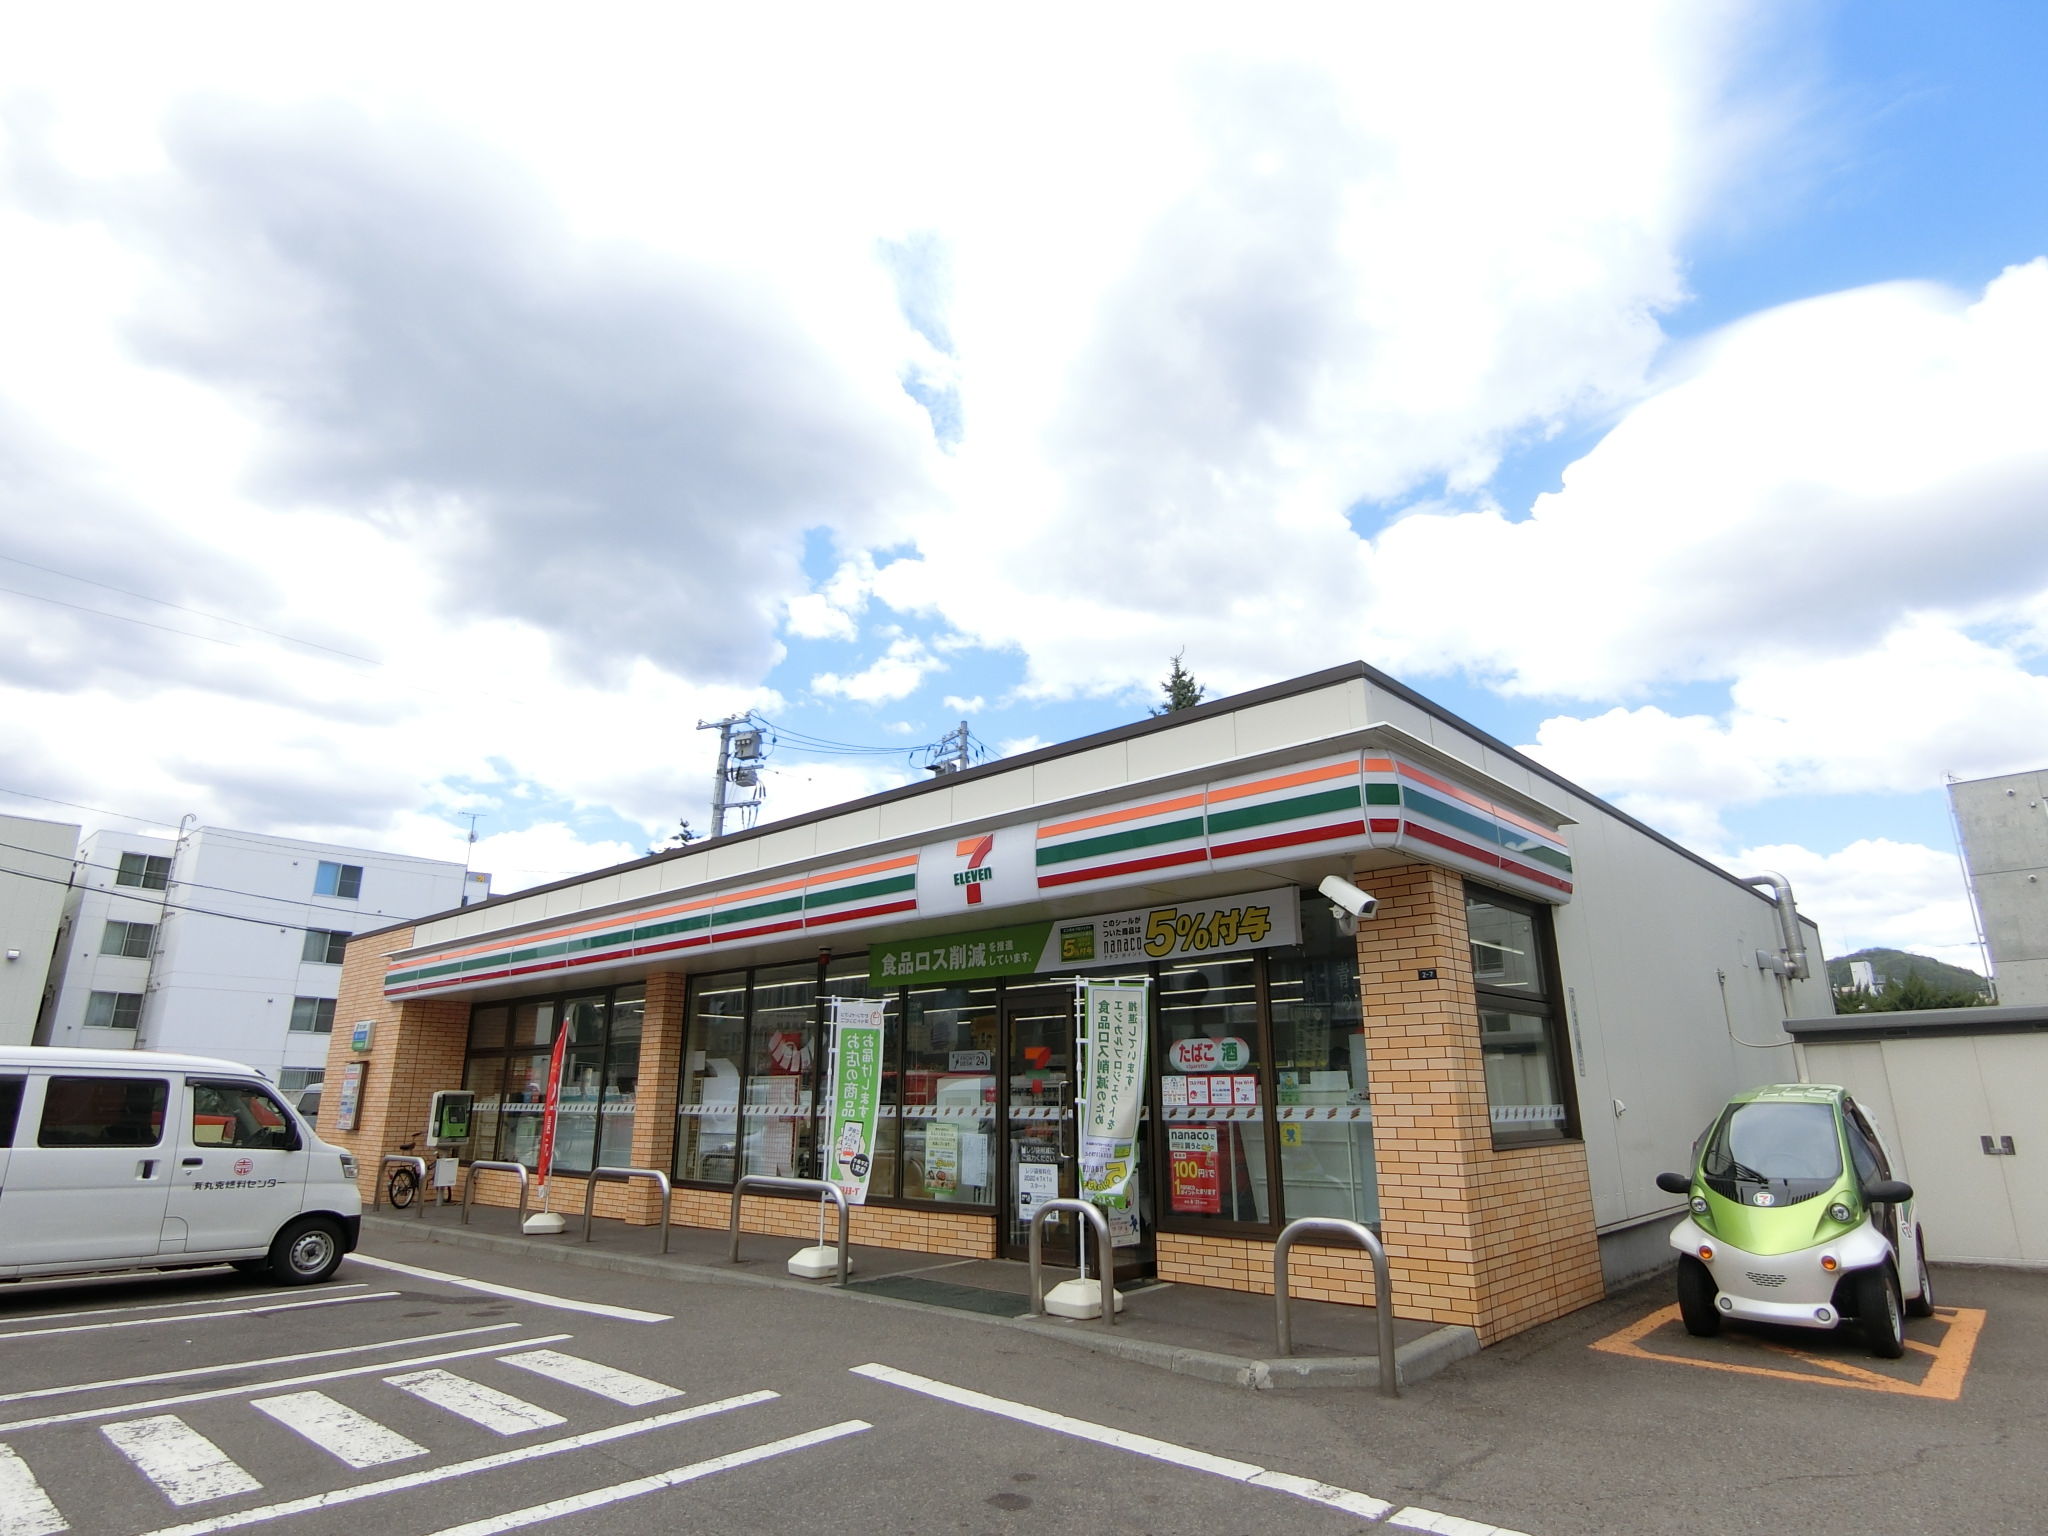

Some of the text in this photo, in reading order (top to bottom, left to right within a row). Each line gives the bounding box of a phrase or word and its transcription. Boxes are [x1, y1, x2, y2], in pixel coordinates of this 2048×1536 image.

[1103, 917, 1141, 928] このシールが
[1103, 927, 1141, 938] ついた商品は
[1144, 906, 1271, 957] 5%付与
[989, 940, 1013, 953] を推進
[1104, 937, 1142, 954] nanaco
[881, 944, 987, 977] 食品ロス削減
[989, 952, 1032, 966] しています。
[1179, 1042, 1238, 1062] たばこ 酒
[976, 1056, 985, 1066] 24
[1185, 1142, 1200, 1150] 買うと
